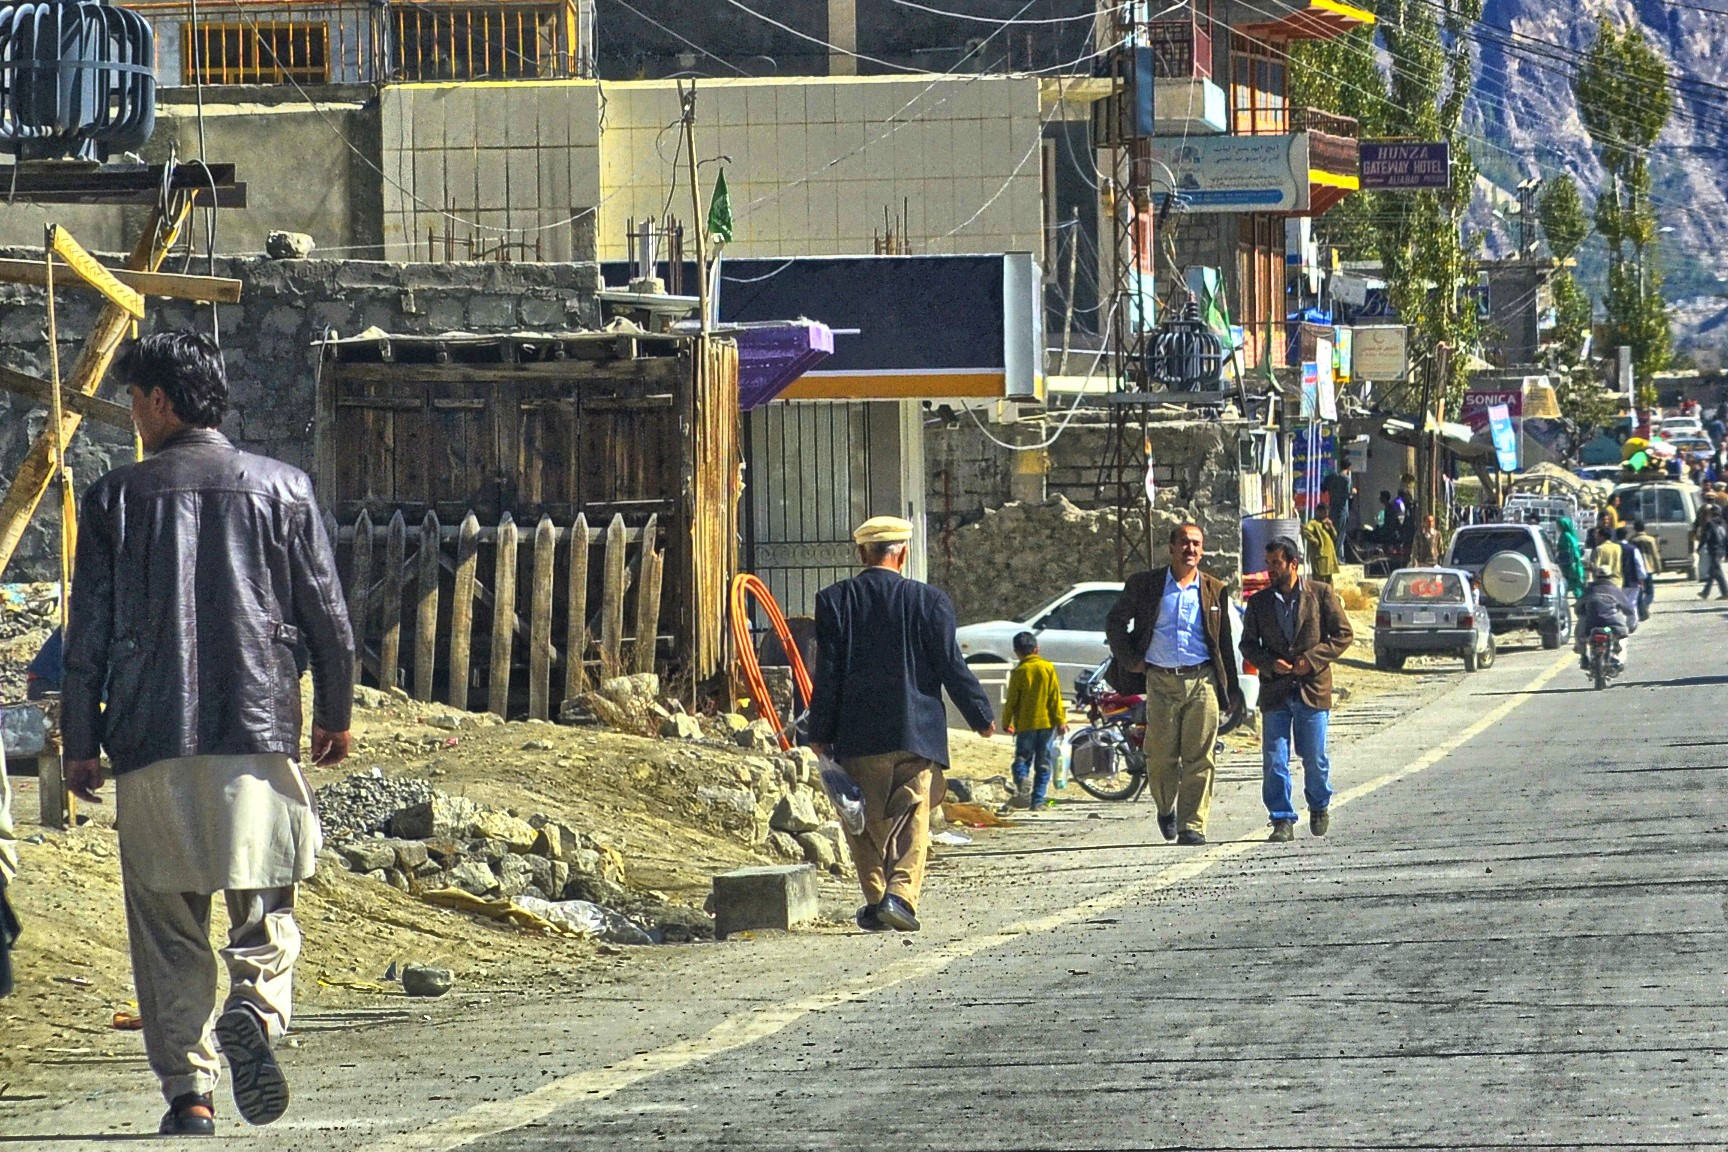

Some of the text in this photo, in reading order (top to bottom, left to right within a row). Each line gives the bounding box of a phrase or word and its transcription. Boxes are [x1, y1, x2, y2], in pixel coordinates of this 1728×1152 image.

[1377, 146, 1429, 160] HUNZA
[1363, 160, 1444, 174] GATEWAY HOTEL
[1466, 394, 1516, 405] SONICA
